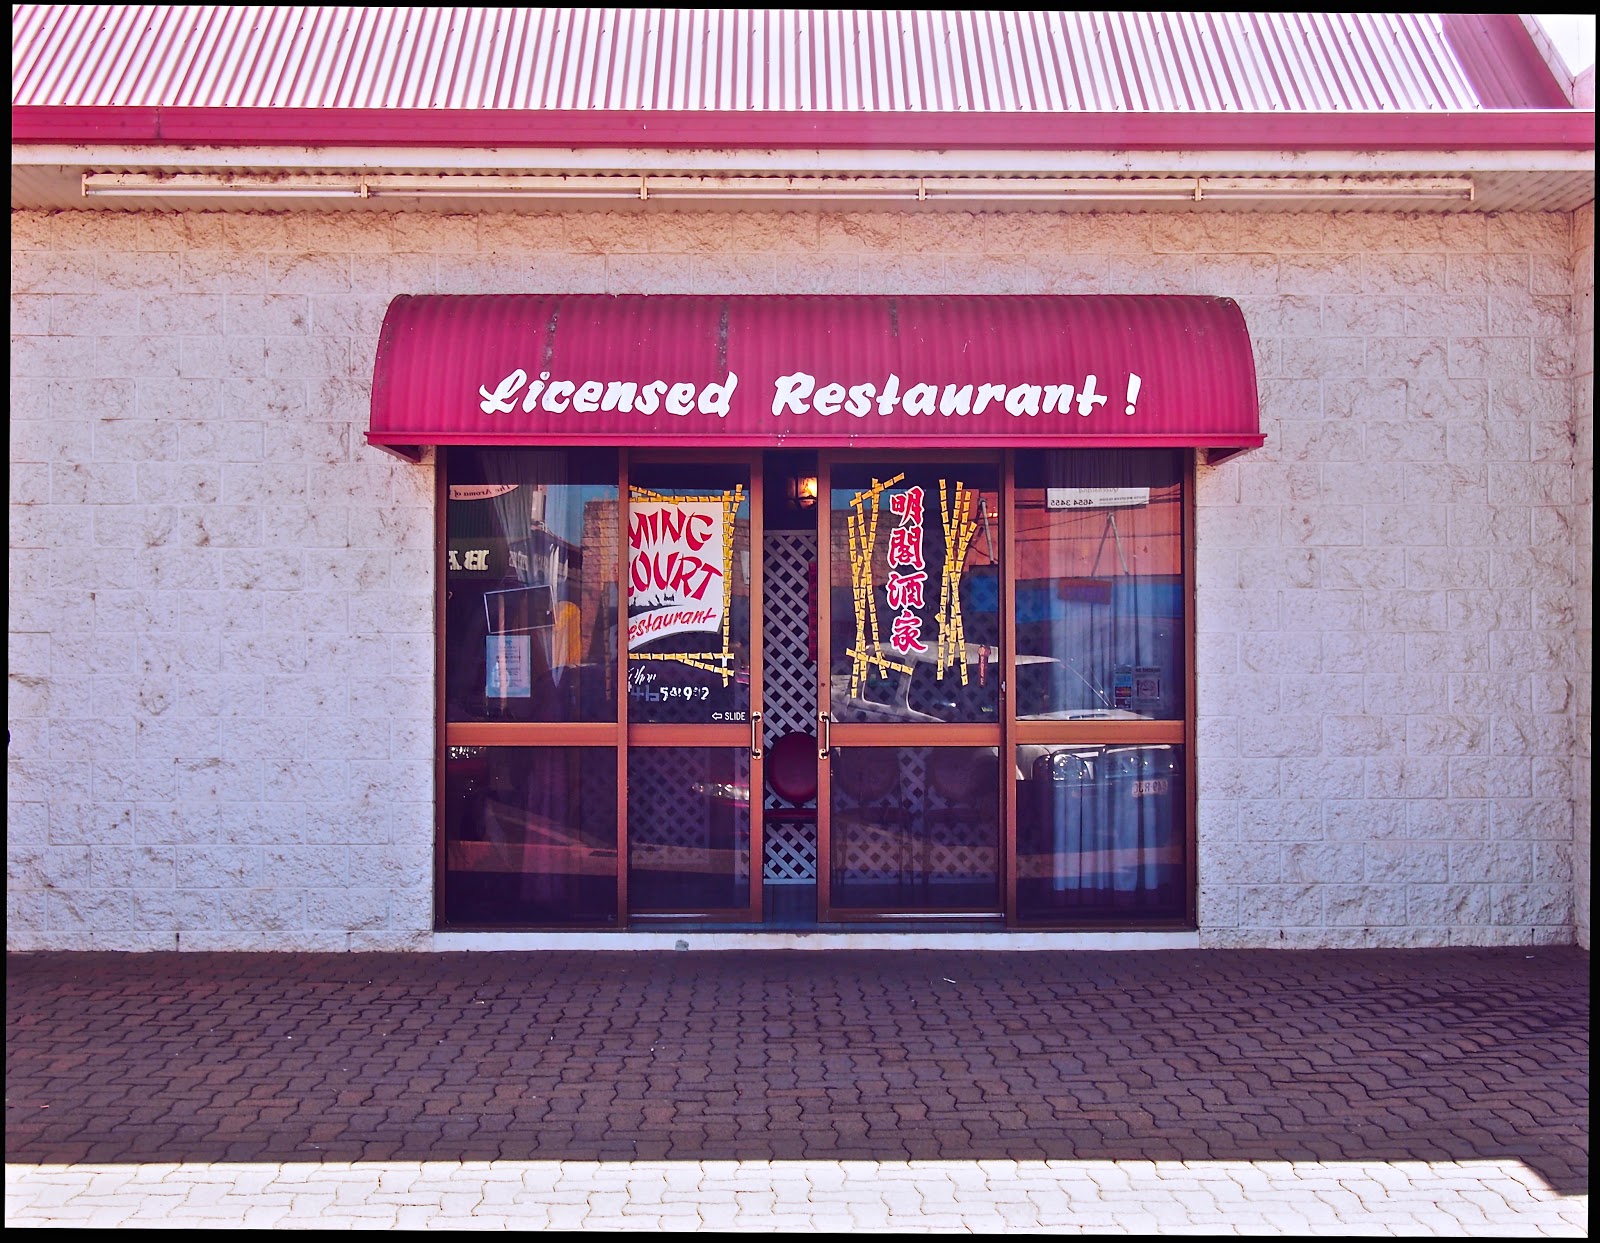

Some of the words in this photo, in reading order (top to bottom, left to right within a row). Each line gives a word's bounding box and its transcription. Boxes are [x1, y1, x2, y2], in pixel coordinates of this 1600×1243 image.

[479, 367, 738, 418] Licensed
[772, 372, 1108, 418] Restaurant
[1123, 373, 1141, 415] !
[629, 507, 713, 551] MING
[629, 550, 723, 601] OURT
[885, 485, 928, 655] 明閣酒家
[629, 607, 717, 641] estaurant
[724, 711, 746, 721] SLIDE
